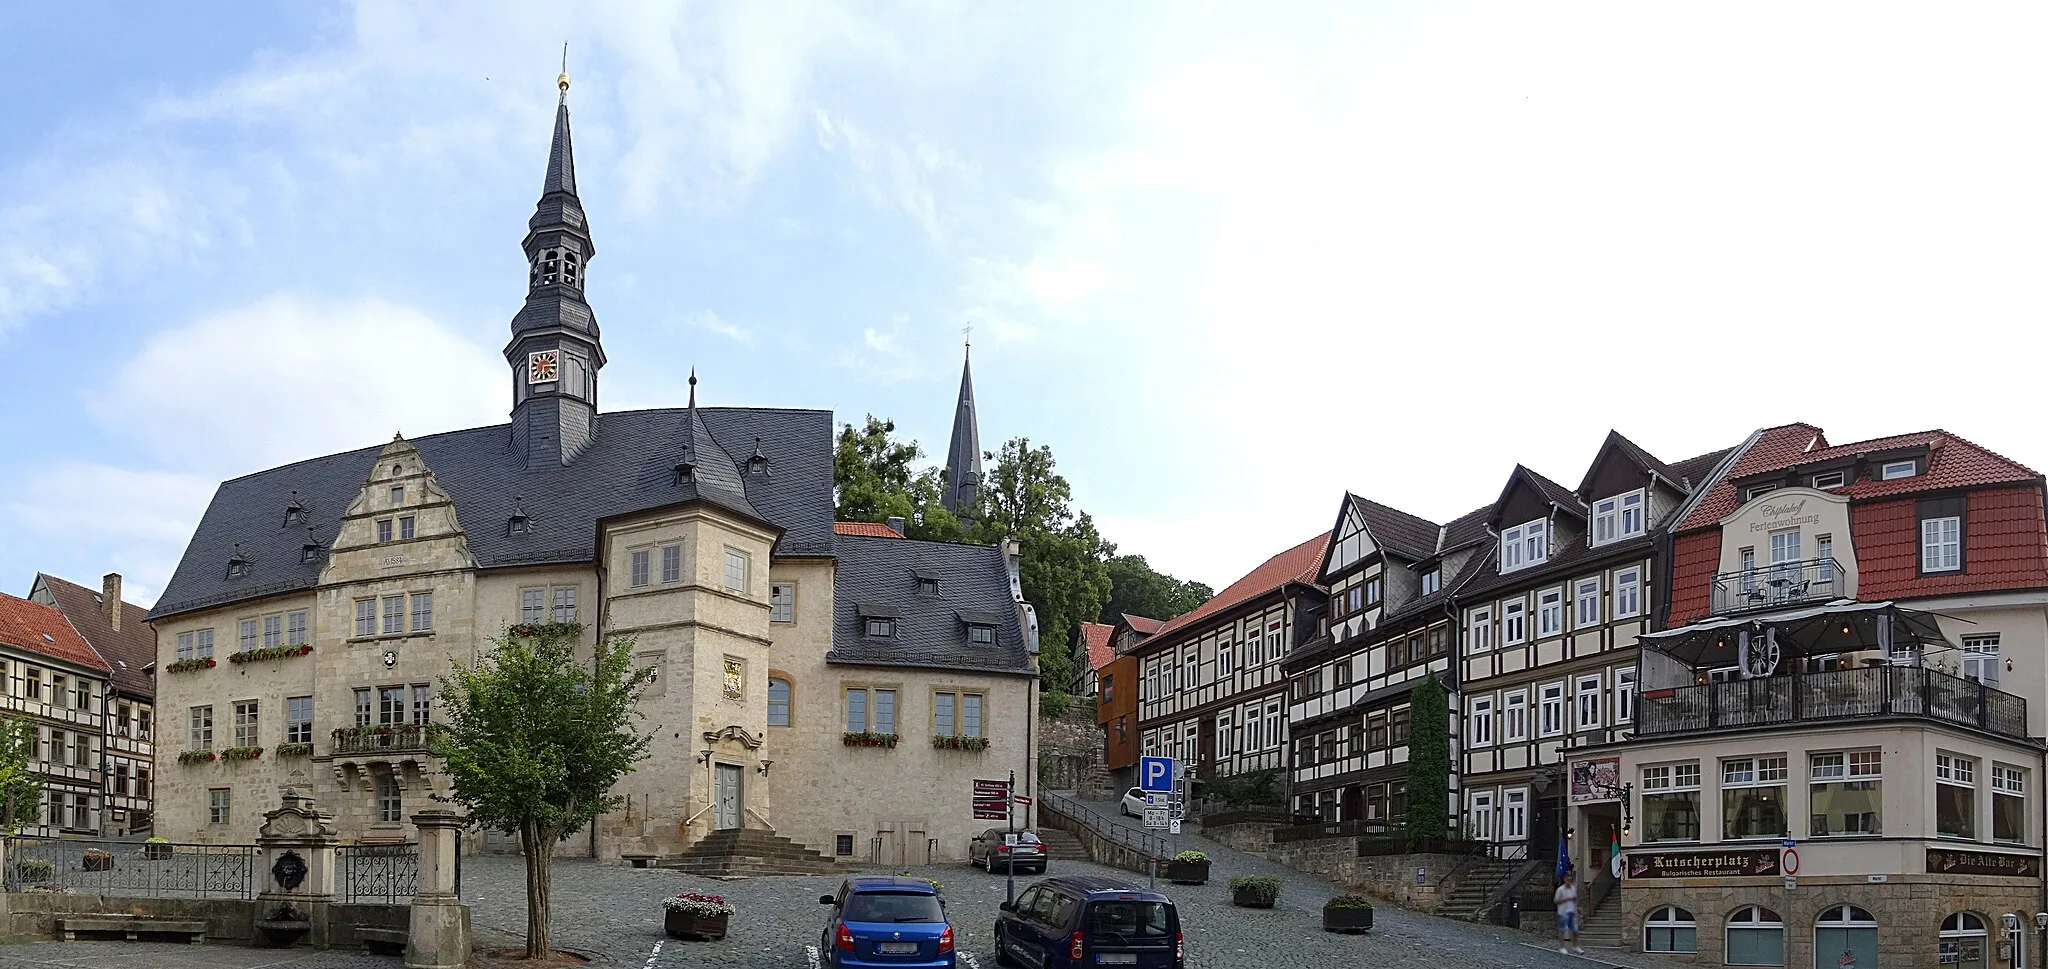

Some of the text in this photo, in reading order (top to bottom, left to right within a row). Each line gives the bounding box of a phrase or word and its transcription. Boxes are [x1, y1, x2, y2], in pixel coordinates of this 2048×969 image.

[1750, 514, 1819, 532] Ferienwohnung
[1148, 761, 1166, 787] P
[1654, 855, 1749, 868] Kutscherplatz
[1960, 853, 1975, 866] Die
[1977, 855, 1996, 868] Alte
[1998, 856, 2015, 868] Bar
